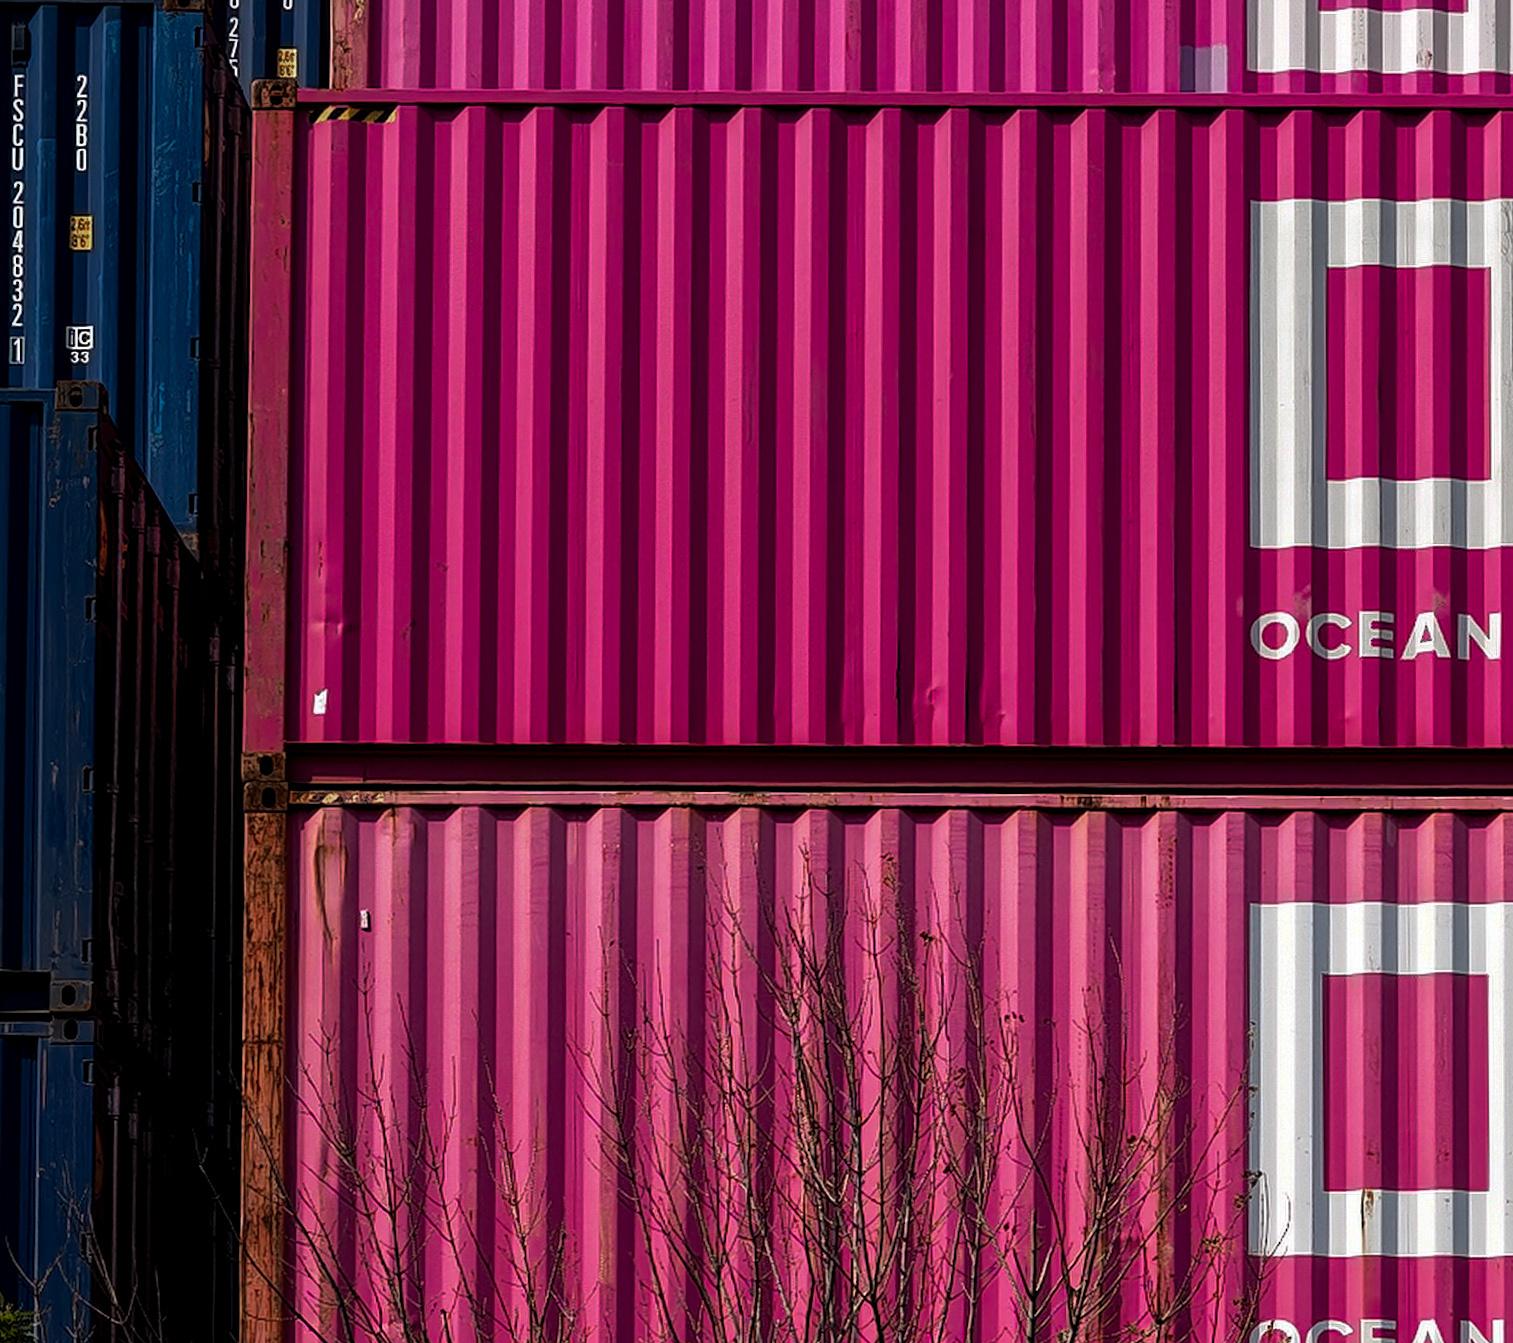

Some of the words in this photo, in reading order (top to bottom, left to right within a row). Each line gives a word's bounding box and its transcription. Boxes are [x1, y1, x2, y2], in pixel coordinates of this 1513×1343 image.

[12, 74, 25, 171] FSCU
[11, 180, 24, 327] 204832
[70, 351, 90, 364] 33
[1249, 610, 1502, 662] OCEAN
